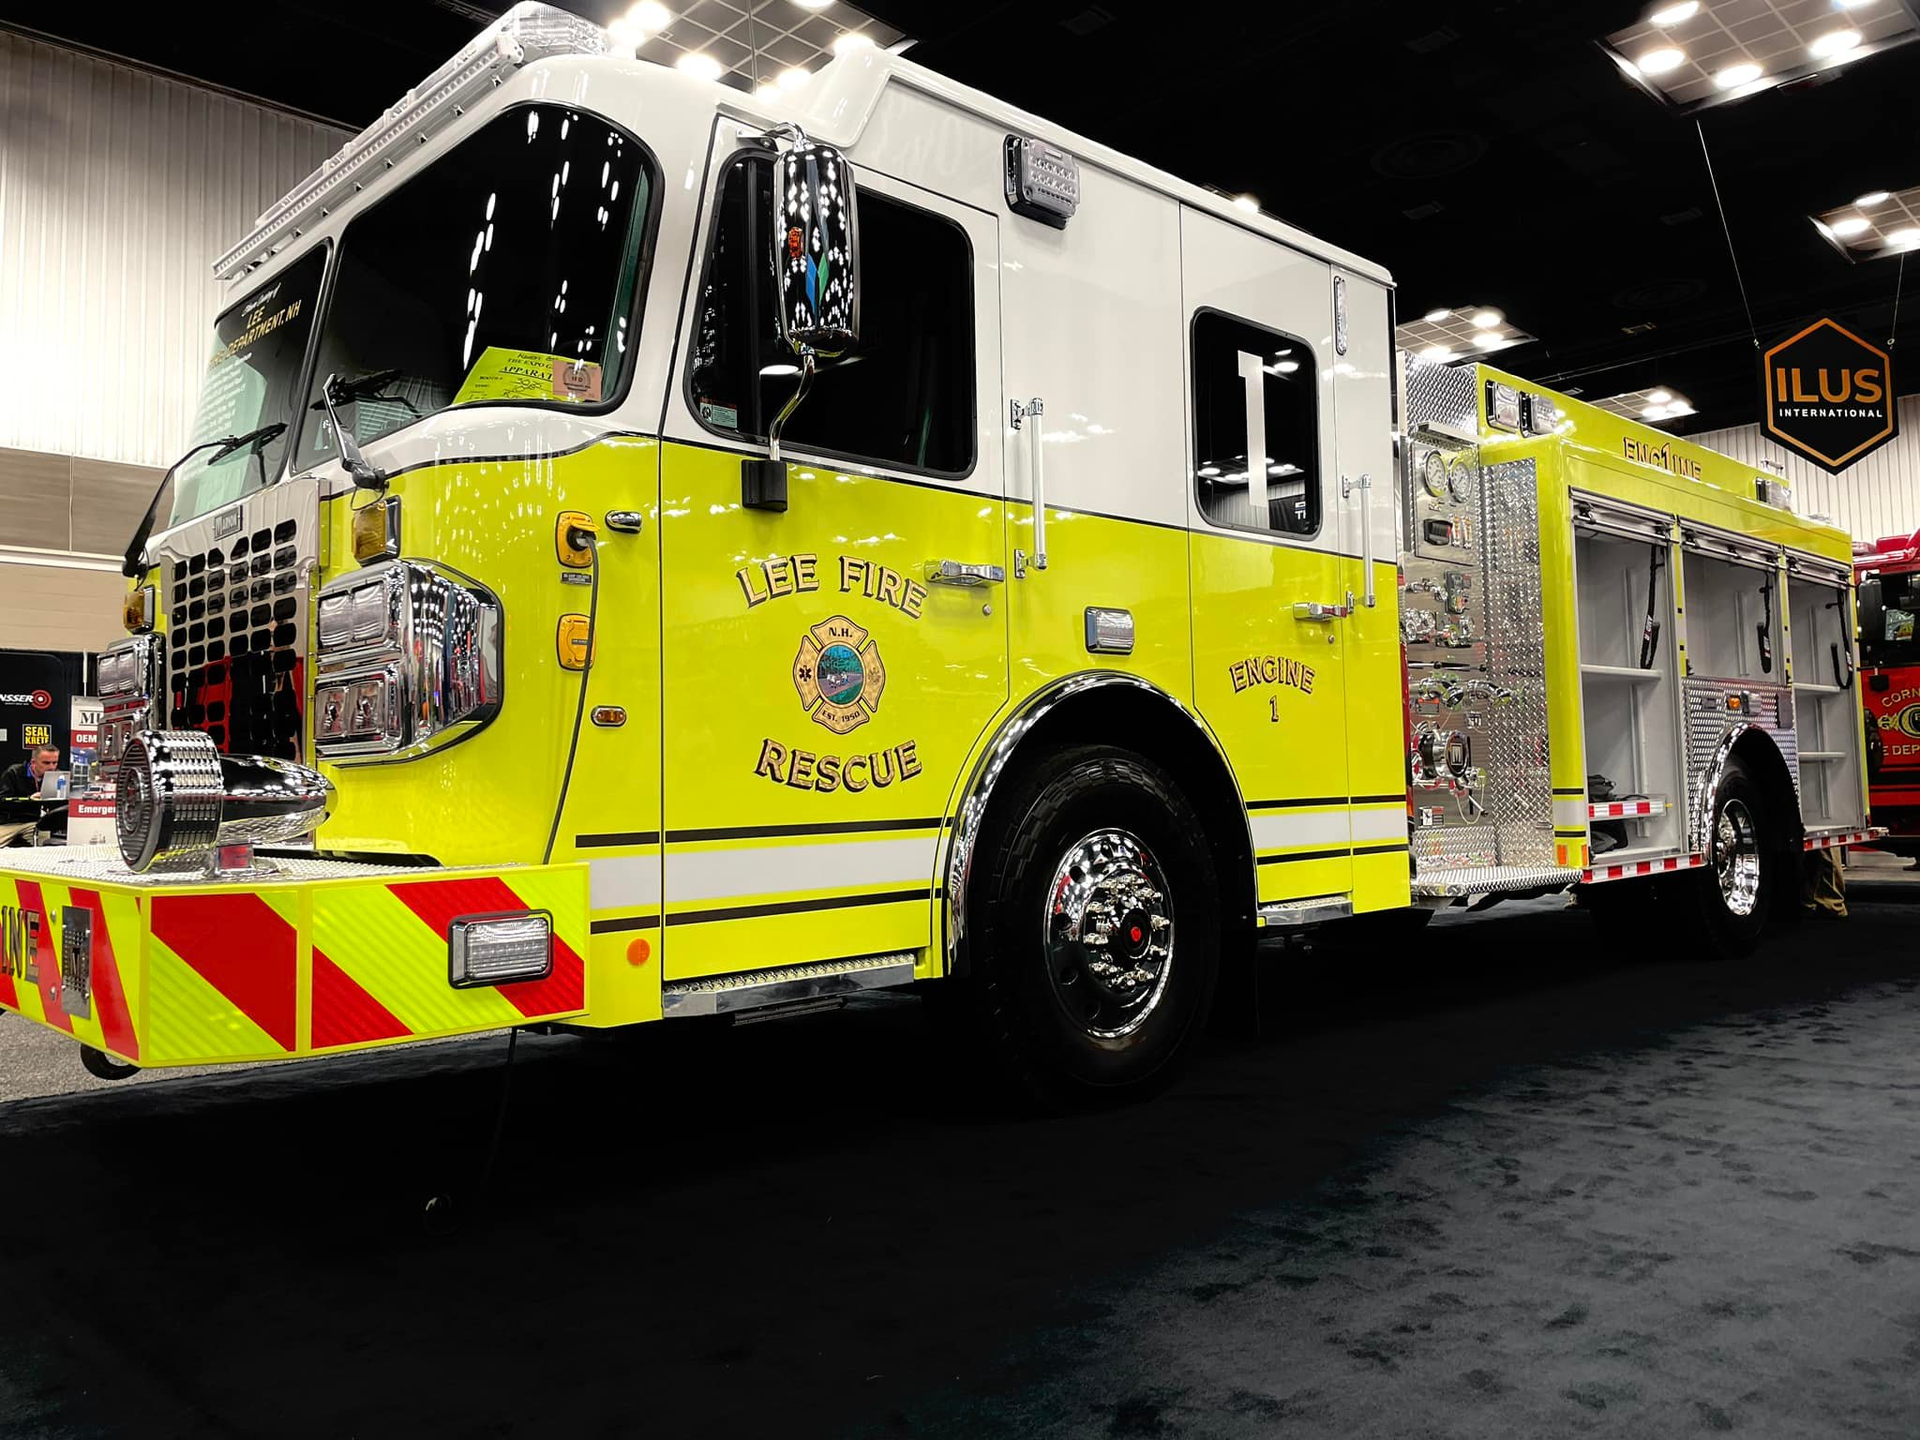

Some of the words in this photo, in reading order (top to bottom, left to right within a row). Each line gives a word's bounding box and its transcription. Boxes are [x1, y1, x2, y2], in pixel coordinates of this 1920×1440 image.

[246, 305, 265, 329] LEE
[1776, 367, 1883, 403] ILUS
[1779, 408, 1883, 418] INTERNATIONAL
[736, 554, 820, 609] LEE
[839, 555, 928, 619] FIRE
[828, 627, 853, 638] N.H.
[1229, 655, 1316, 694] ENGINE
[841, 710, 861, 722] 1950
[1269, 695, 1279, 722] 1
[25, 726, 49, 737] SEAL
[76, 733, 98, 743] OEM
[753, 738, 922, 793] RESCUE
